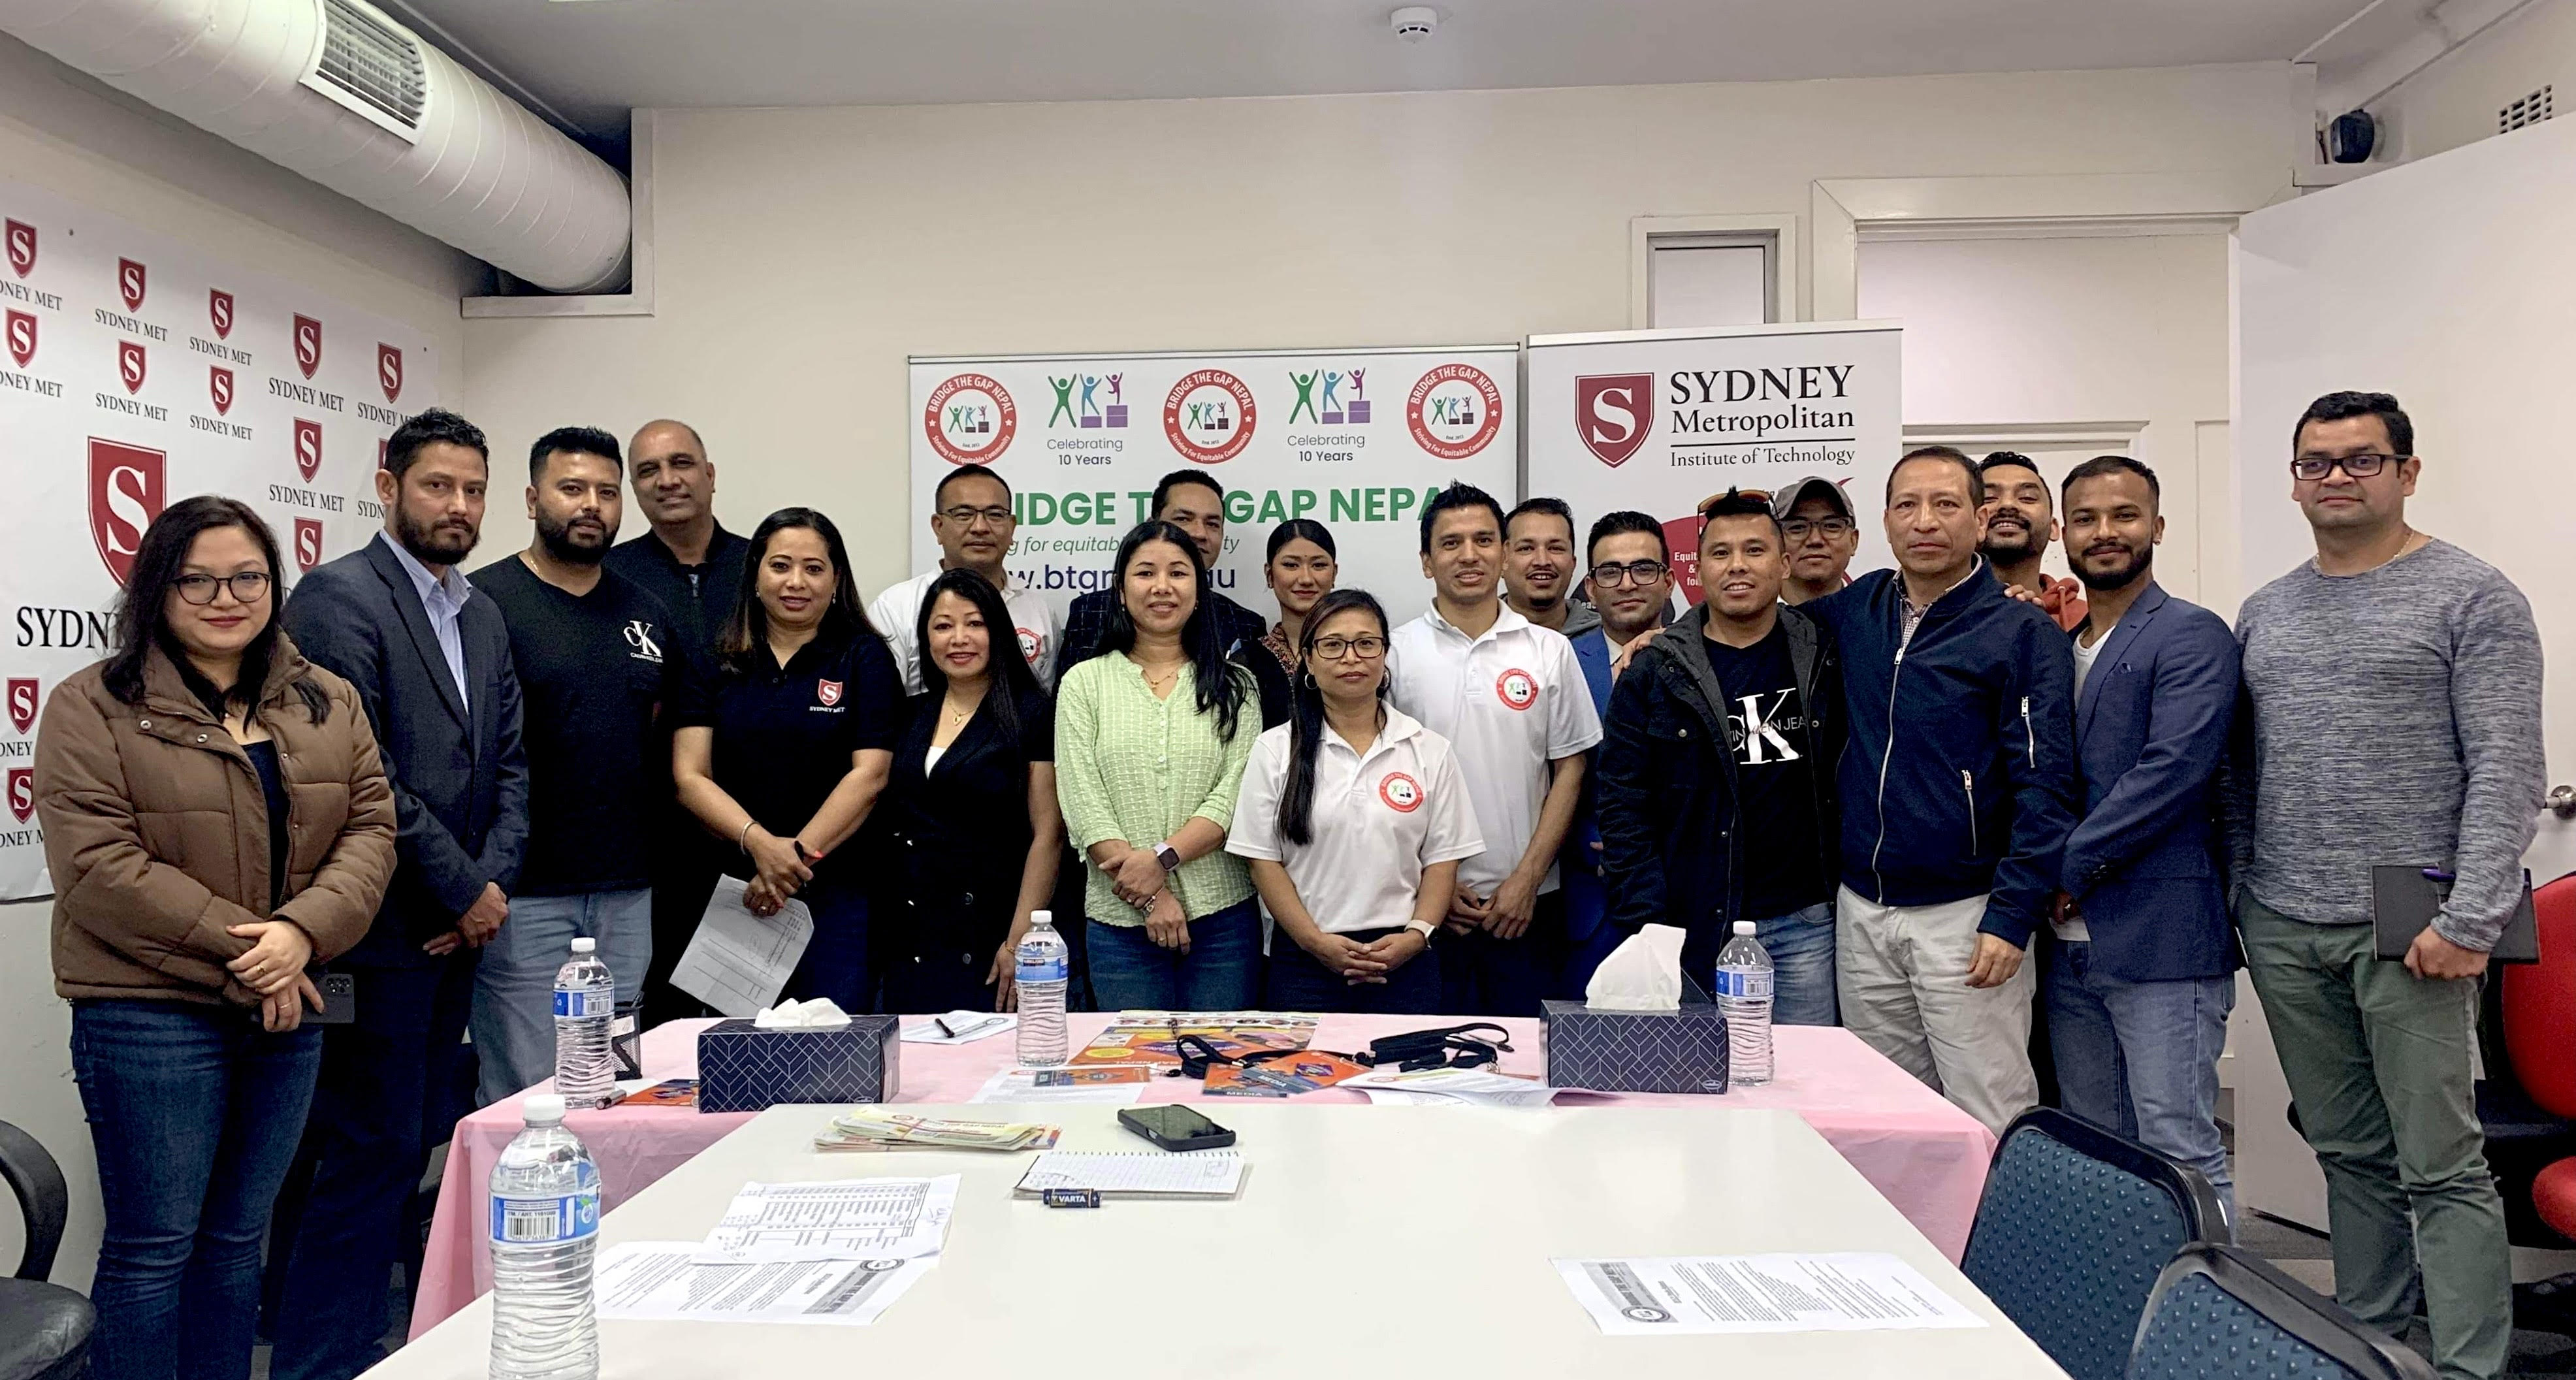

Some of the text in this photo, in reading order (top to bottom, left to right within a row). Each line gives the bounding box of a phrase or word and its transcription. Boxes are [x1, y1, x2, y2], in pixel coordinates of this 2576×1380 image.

[35, 290, 62, 310] MET
[95, 308, 167, 342] SYDNEY MET
[189, 336, 252, 366] SYDNEY MET
[35, 378, 63, 398] MET
[269, 377, 344, 411] SYDNEY MET
[928, 376, 1013, 414] BRIDGE THE GAP NEPAL
[1167, 372, 1253, 410] BRIDGE THE GAP NEPAL
[1411, 366, 1499, 405] BRIDGE THE GAP NEPAL
[1670, 364, 1855, 404] SYDNEY
[95, 393, 167, 421] SYDNEY MET
[357, 402, 398, 426] SYDNEY
[1592, 388, 1635, 443] S
[189, 415, 252, 440] SYDNEY MET
[1671, 404, 1855, 438] Metropolitan
[1047, 438, 1123, 452] Celebrating
[1287, 434, 1365, 448] Celebrating
[1059, 455, 1112, 465] 10 Years
[1300, 451, 1353, 462] 10 Years
[1671, 445, 1855, 466] Institute of Technology
[270, 484, 344, 512] SYDNEY MET
[358, 500, 384, 519] SYDN
[1015, 492, 1116, 526] IDGE
[1225, 489, 1317, 522] GAP
[1330, 487, 1441, 522] NEPA
[1023, 536, 1048, 556] for
[1053, 536, 1119, 555] equitab
[1674, 551, 1698, 562] Equit
[1688, 564, 1696, 573] &
[16, 606, 122, 649] SYDN
[1783, 716, 1807, 731] JEA
[1059, 1195, 1086, 1203] VARTA
